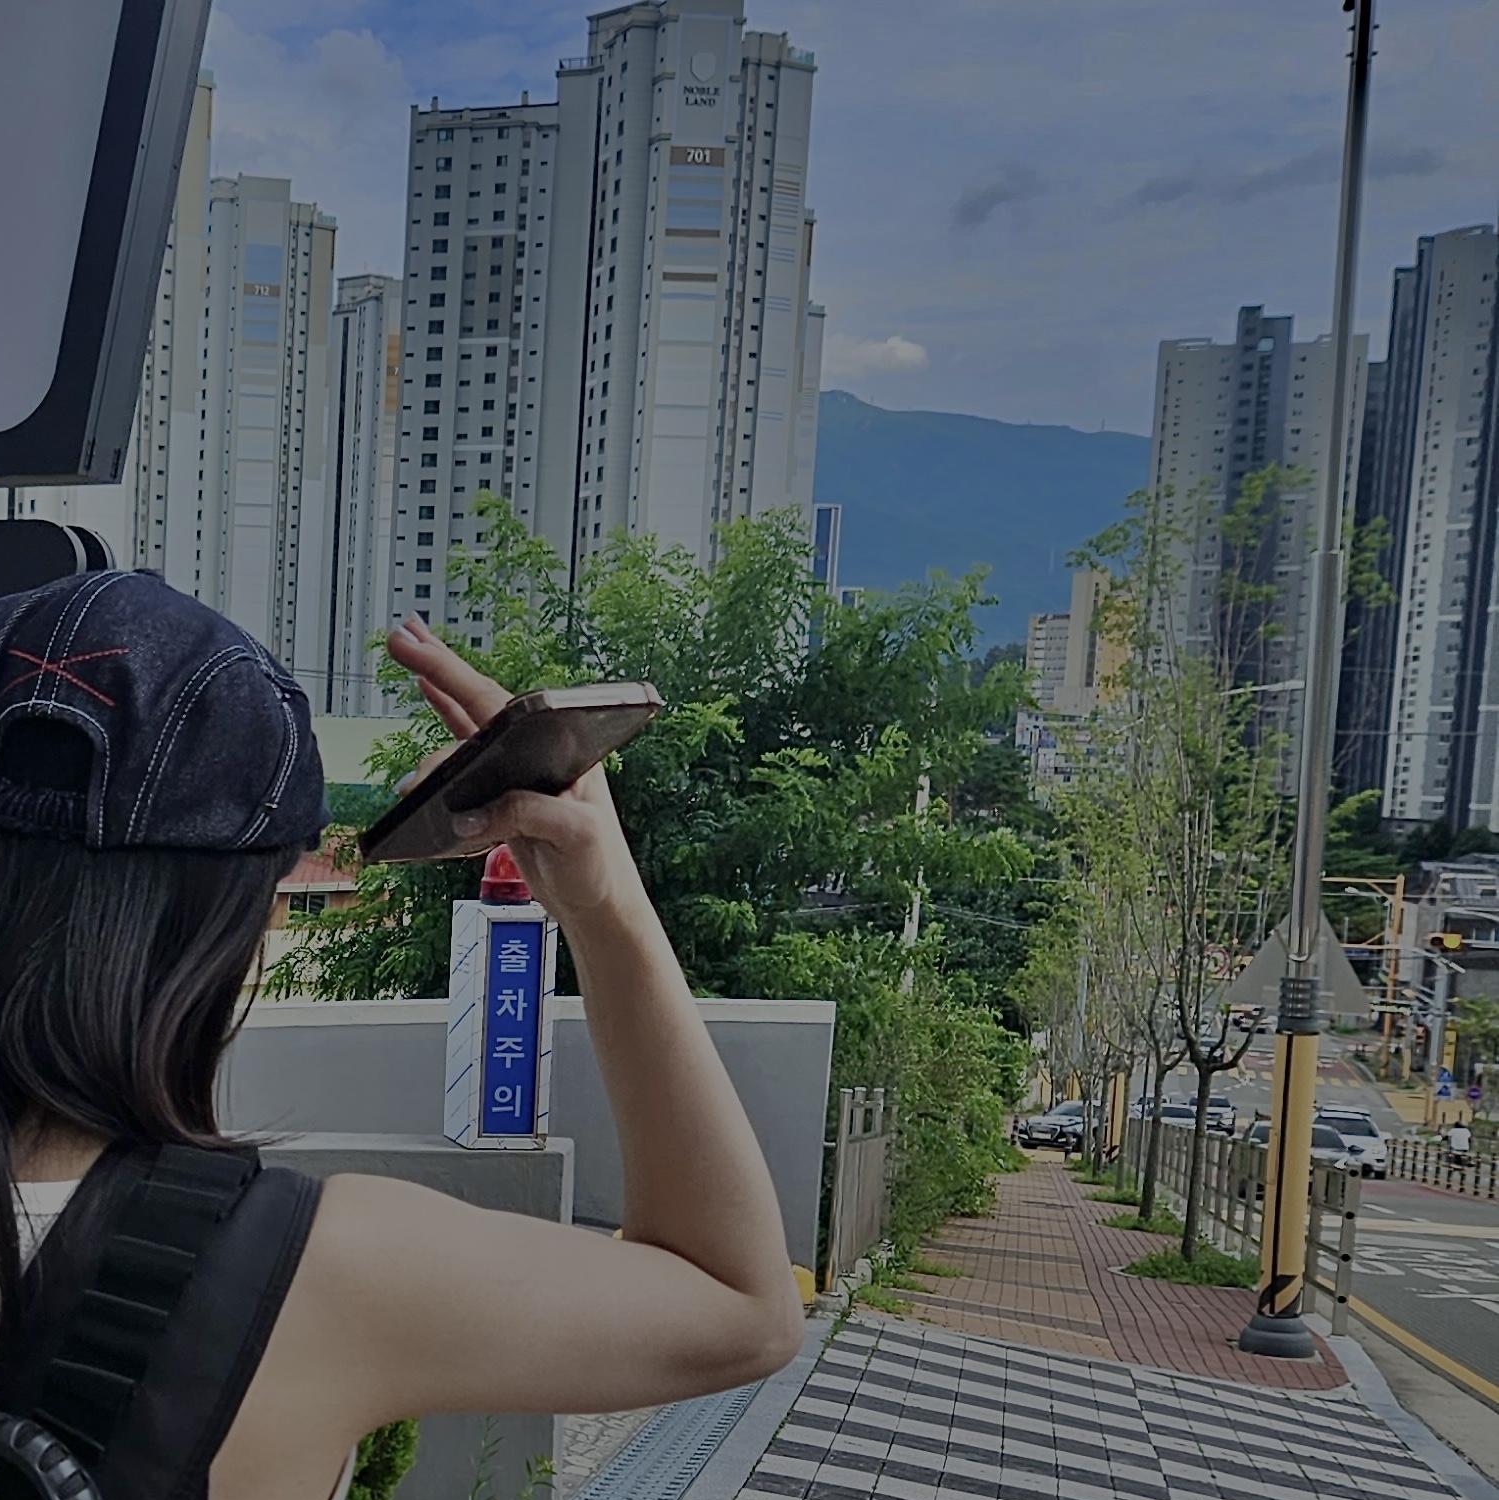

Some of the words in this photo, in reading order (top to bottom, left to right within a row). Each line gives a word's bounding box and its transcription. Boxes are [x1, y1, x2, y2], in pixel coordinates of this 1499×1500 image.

[685, 97, 716, 106] LAND
[686, 147, 711, 164] 701
[254, 285, 270, 296] 712
[491, 939, 531, 1118] 출차주의
